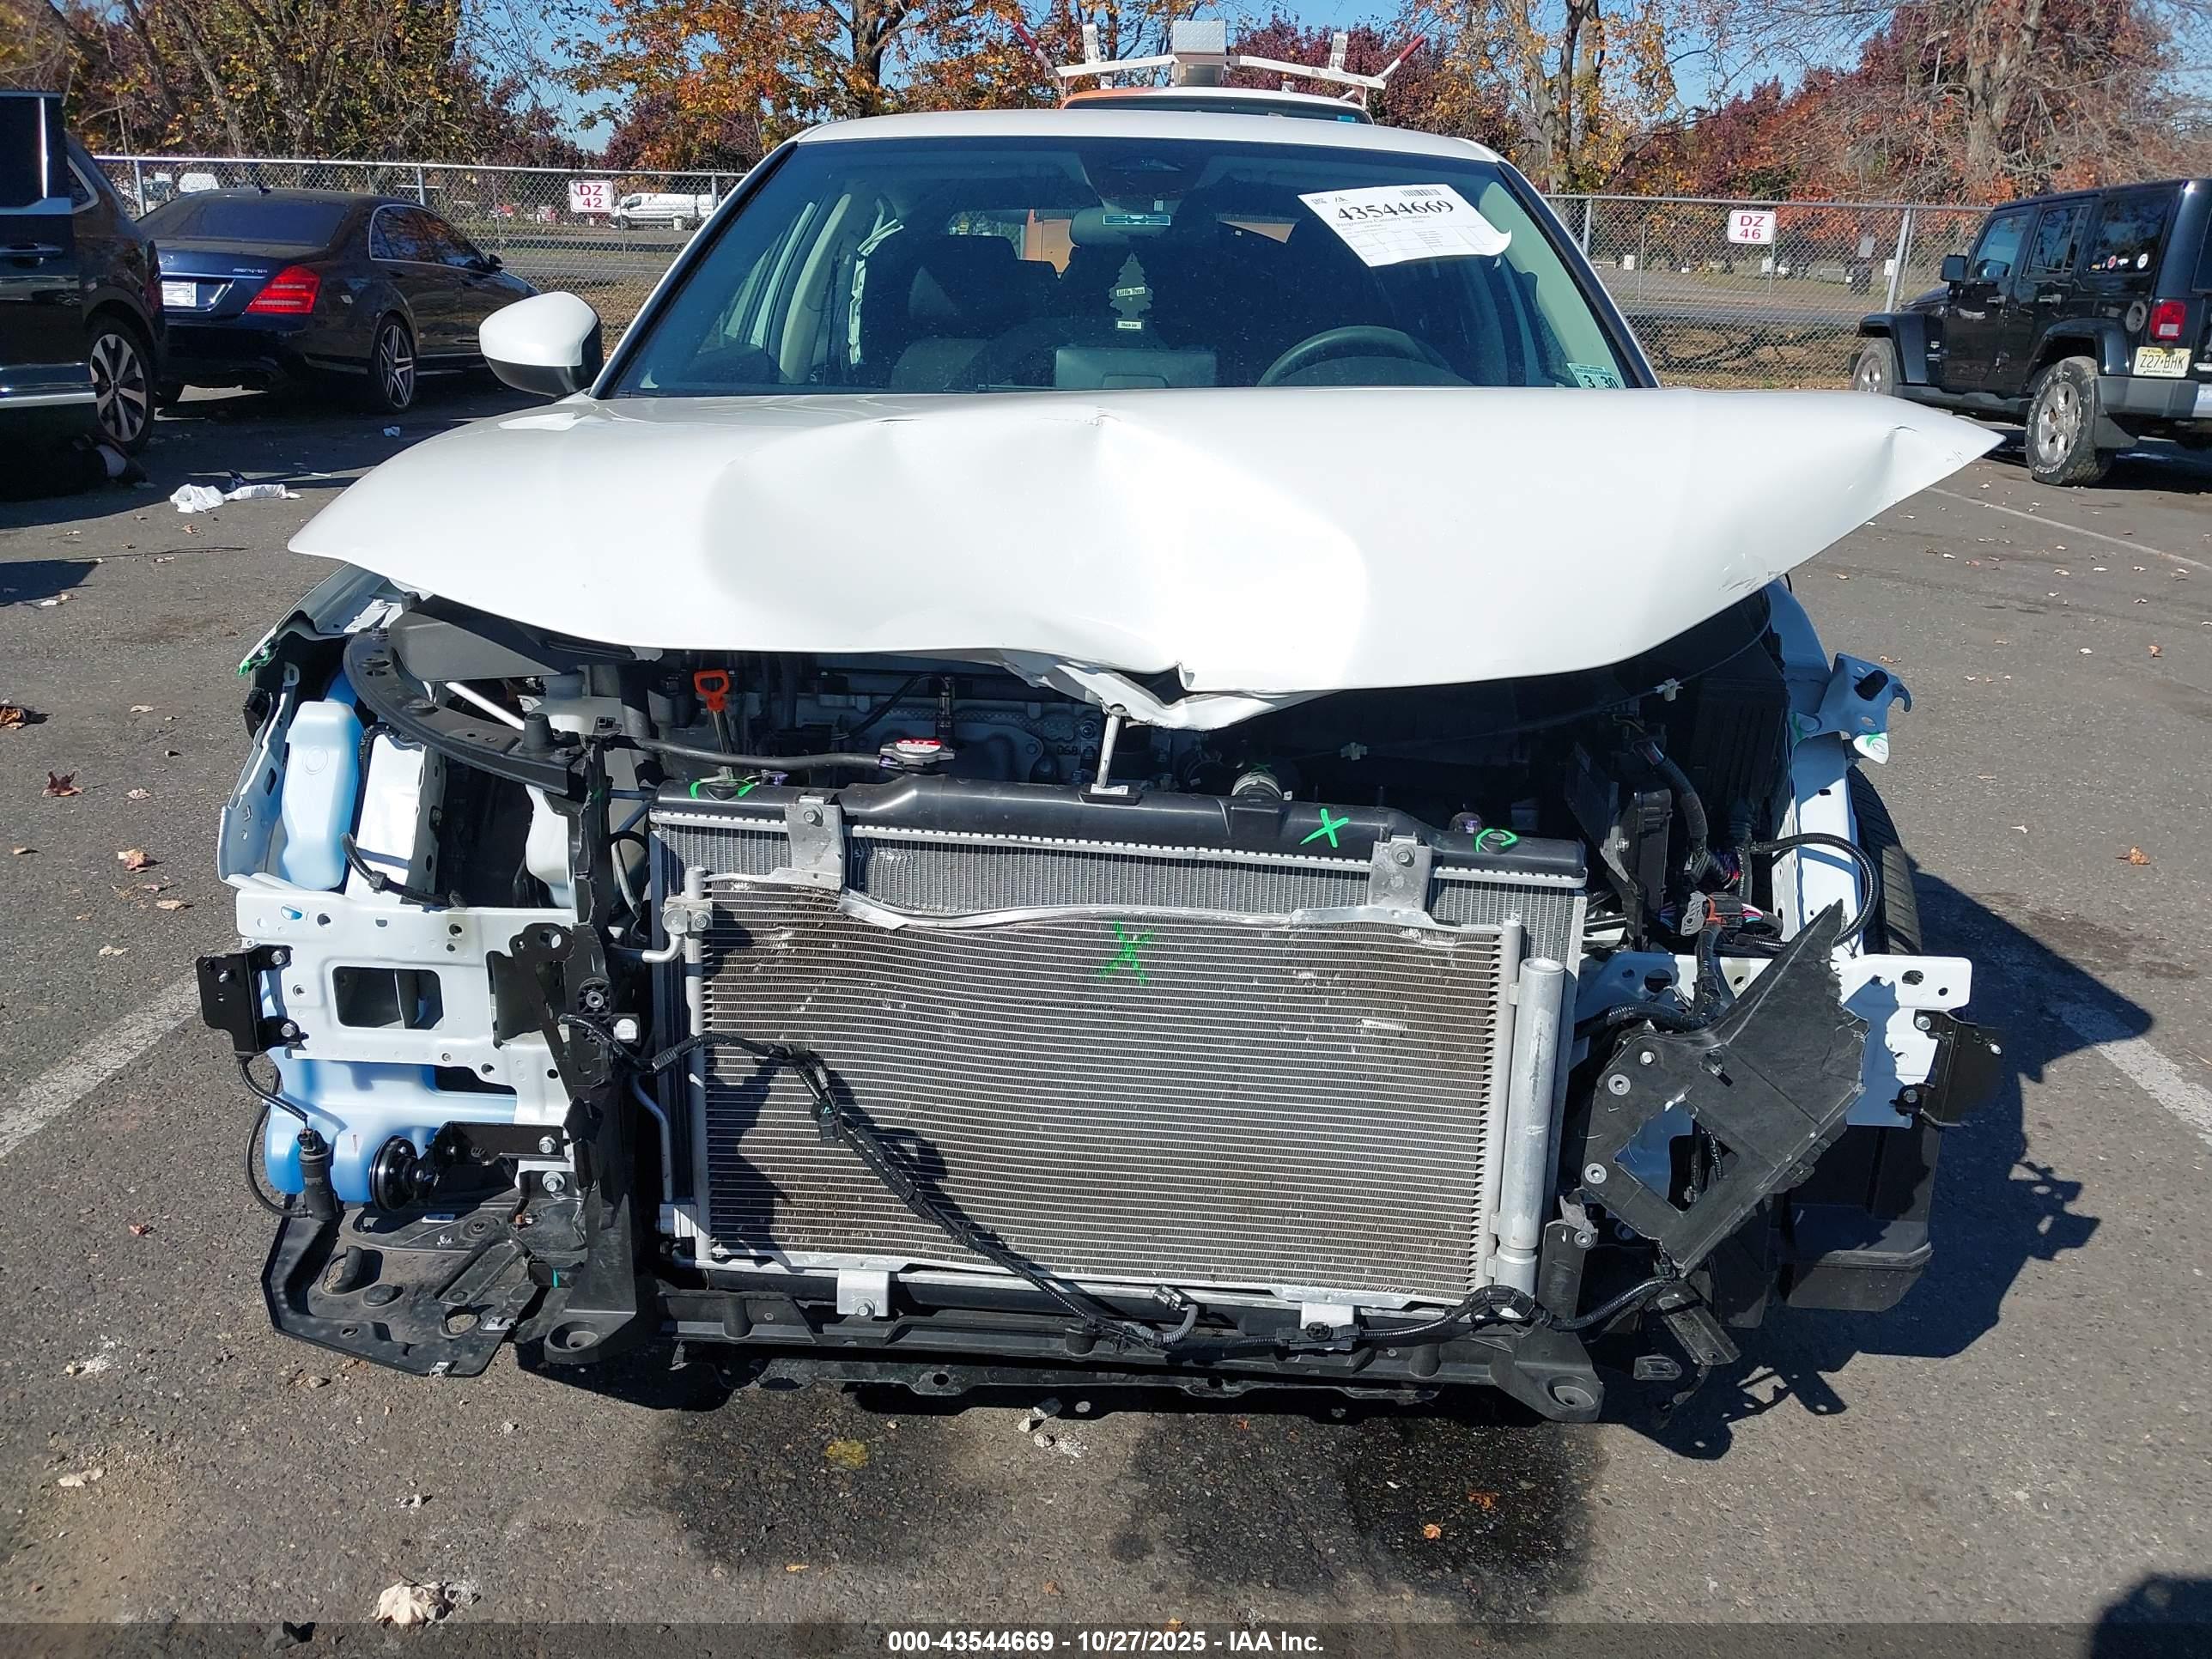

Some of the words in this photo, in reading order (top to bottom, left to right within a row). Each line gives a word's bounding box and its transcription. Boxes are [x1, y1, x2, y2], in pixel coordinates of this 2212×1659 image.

[580, 185, 604, 196] DZ
[582, 197, 603, 208] 42
[1338, 199, 1454, 221] 43544669
[1740, 215, 1765, 228] DZ
[1739, 228, 1761, 240] 46
[1583, 374, 1596, 388] 3
